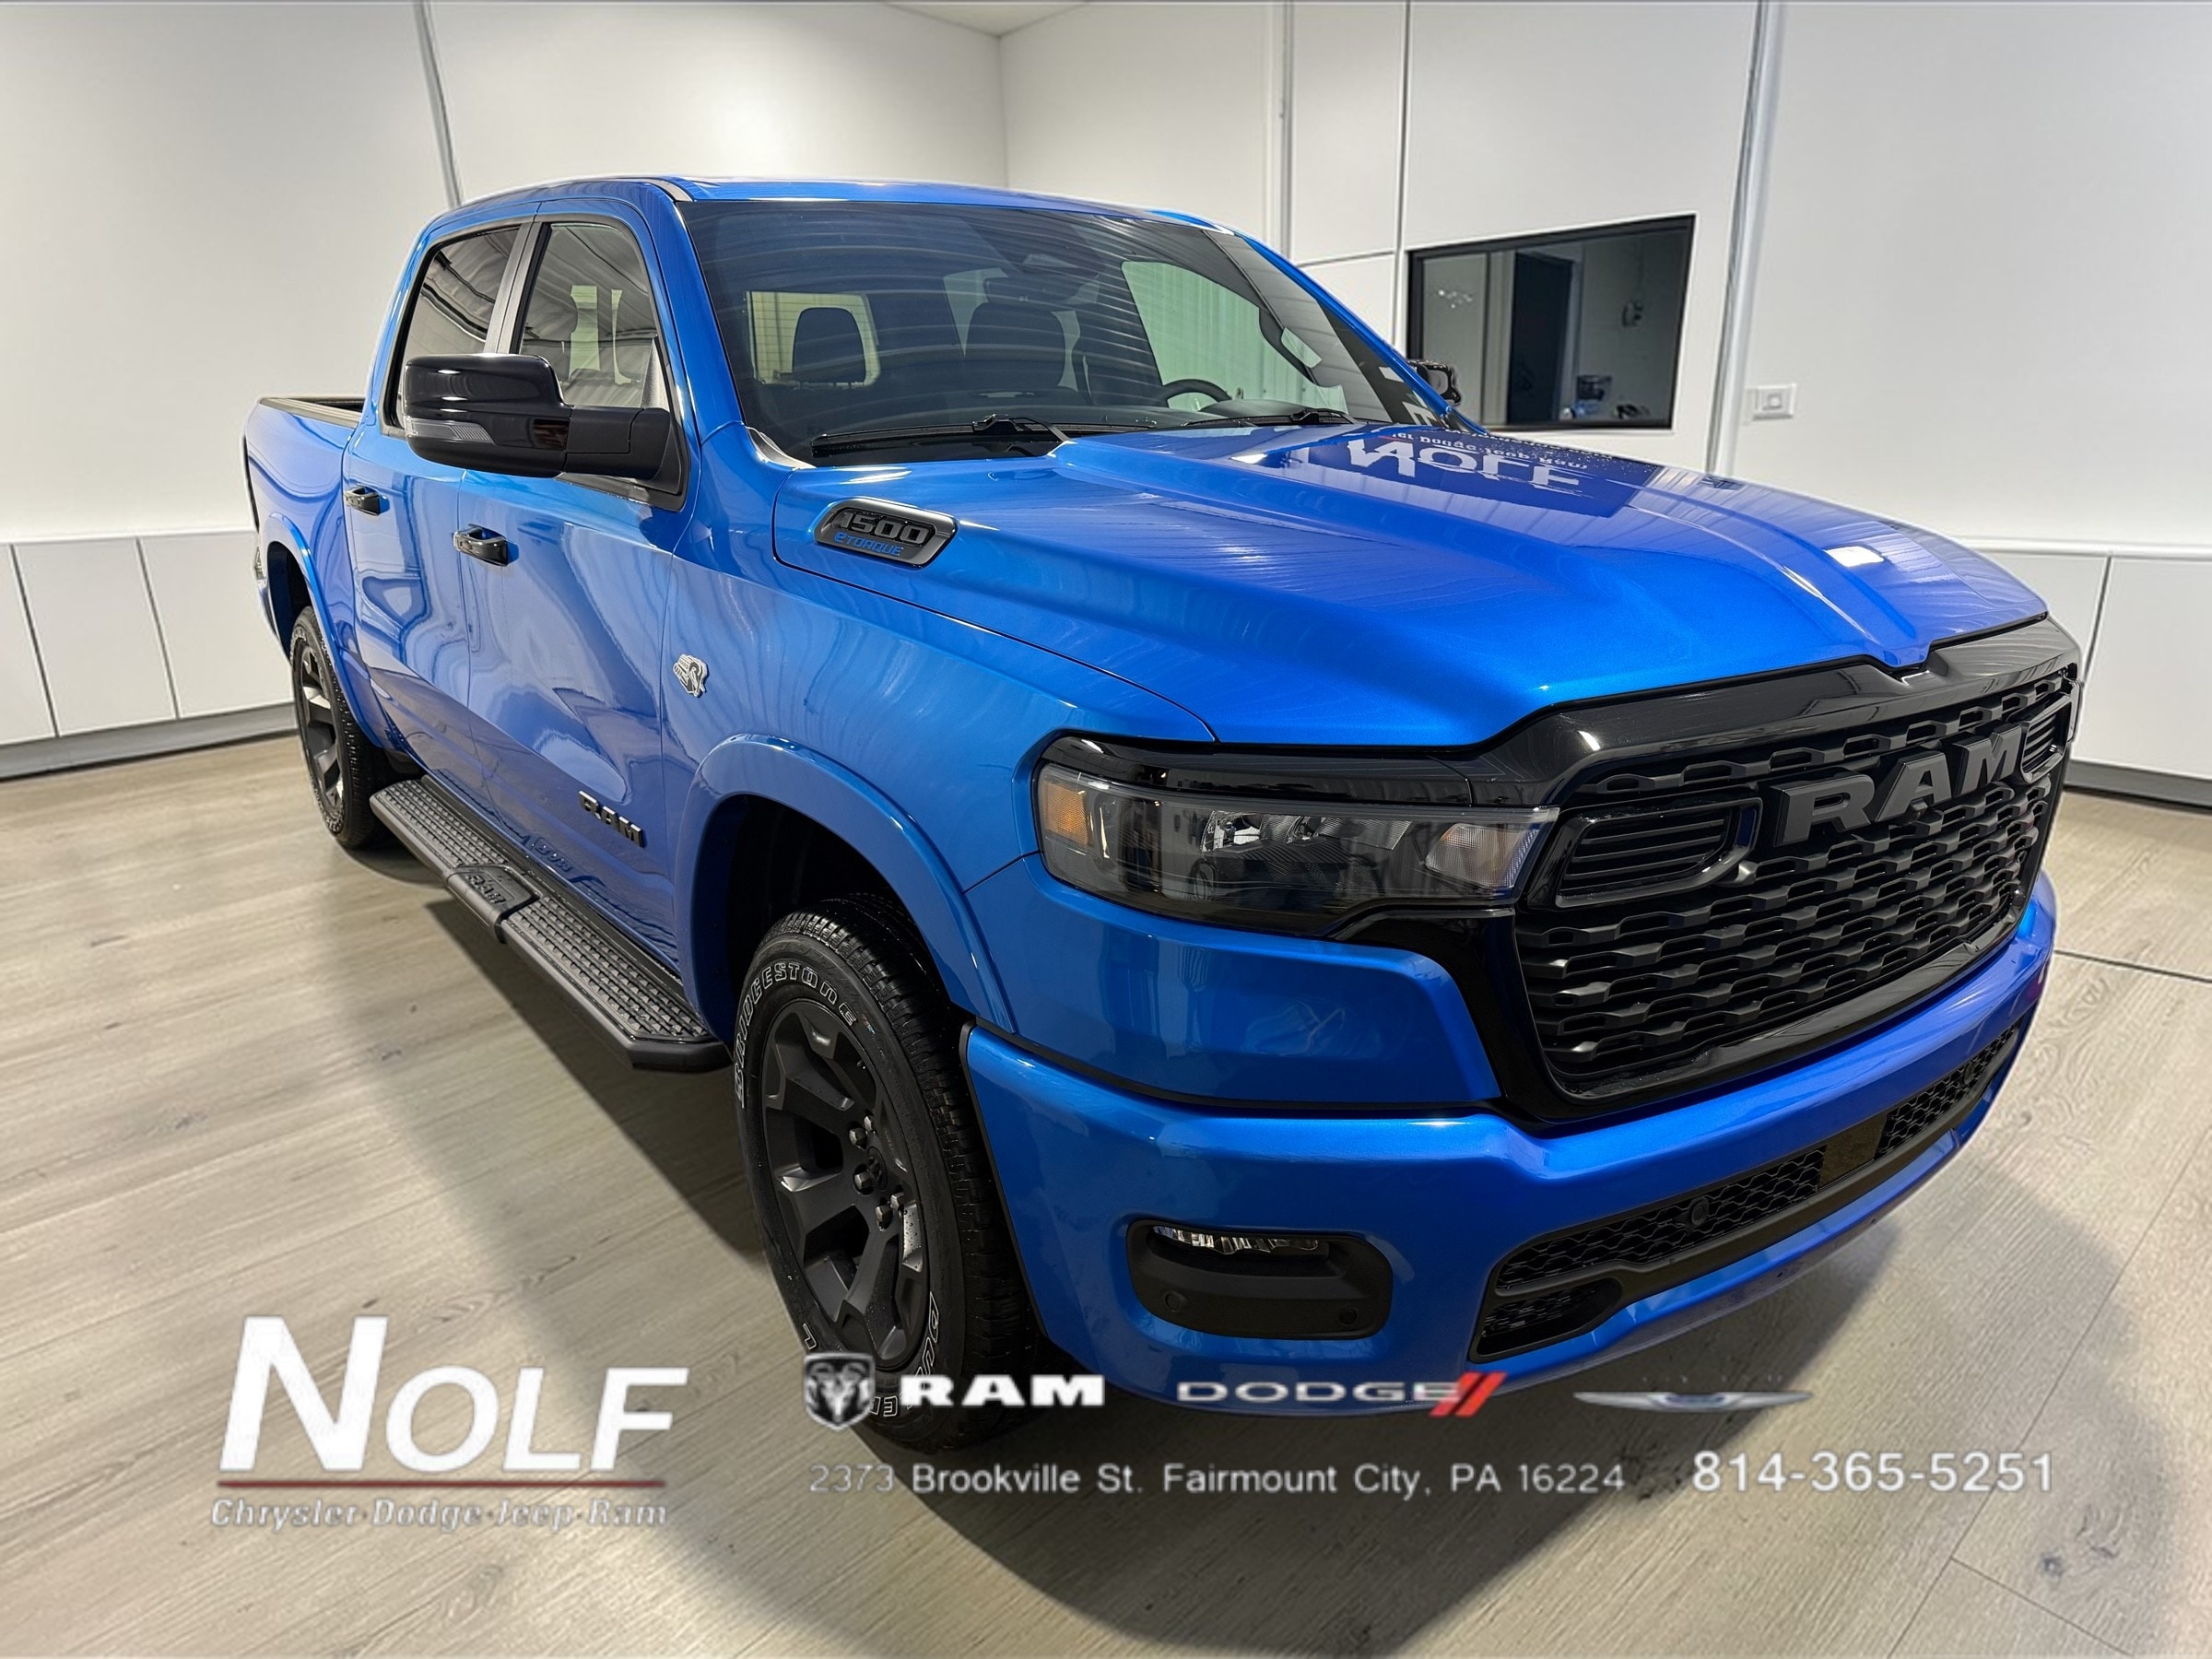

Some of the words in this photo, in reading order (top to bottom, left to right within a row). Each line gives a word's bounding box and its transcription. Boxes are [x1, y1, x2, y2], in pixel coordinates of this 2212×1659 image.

[831, 512, 931, 545] 1500
[1774, 723, 2023, 846] RAM
[579, 790, 647, 848] RAM
